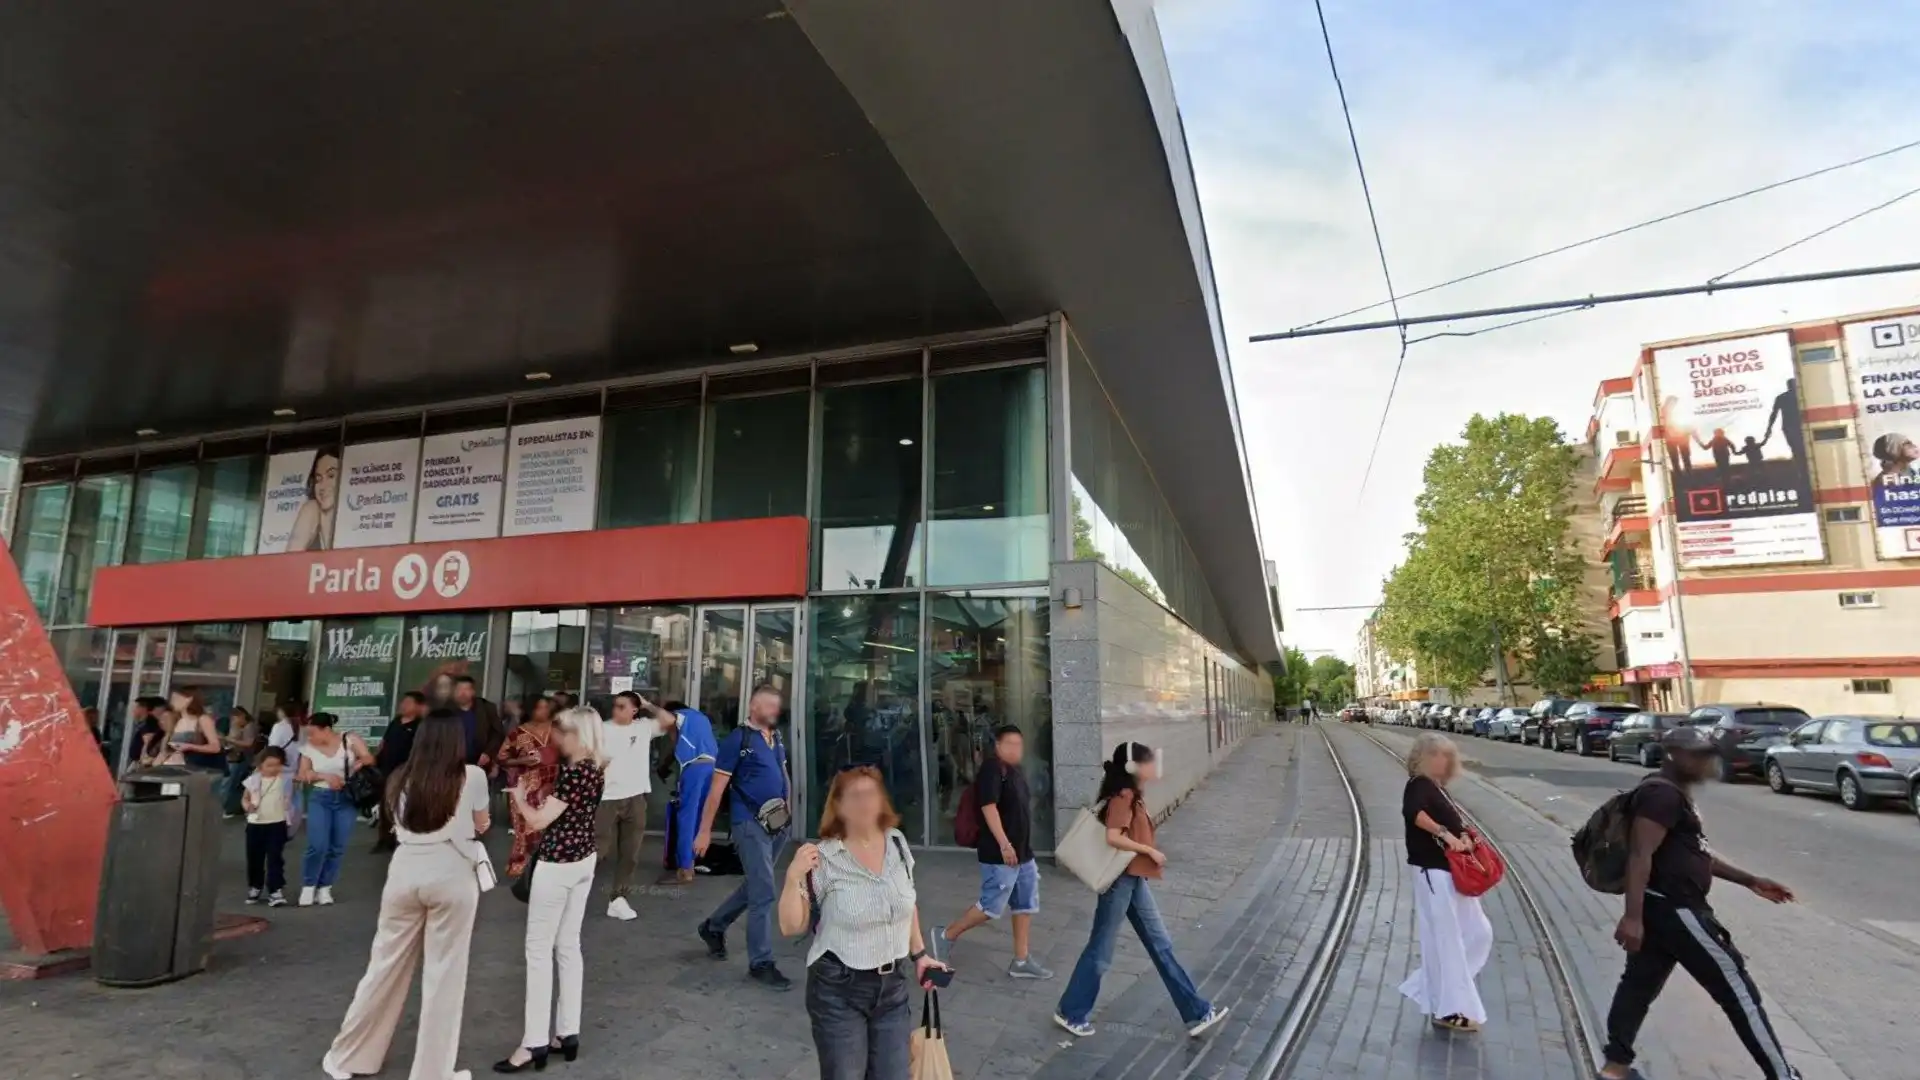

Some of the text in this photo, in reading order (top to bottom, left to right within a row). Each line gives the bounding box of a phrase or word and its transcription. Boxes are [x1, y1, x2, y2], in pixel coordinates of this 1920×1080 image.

[1686, 349, 1760, 369] TÚ NOS
[1690, 361, 1764, 379] CUENTAS
[1691, 378, 1713, 389] TU
[1863, 388, 1885, 399] LA
[518, 429, 594, 446] ESPECIALISTAS EN:
[391, 462, 402, 471] DE
[425, 455, 460, 467] PRIMERA
[424, 466, 472, 478] CONSULTA Y
[436, 492, 480, 508] GRATIS
[1726, 488, 1799, 506] redpiso
[308, 558, 381, 594] Parla
[326, 628, 398, 661] Westfield
[409, 624, 487, 660] Westfield
[350, 682, 385, 697] FESTIVAL
